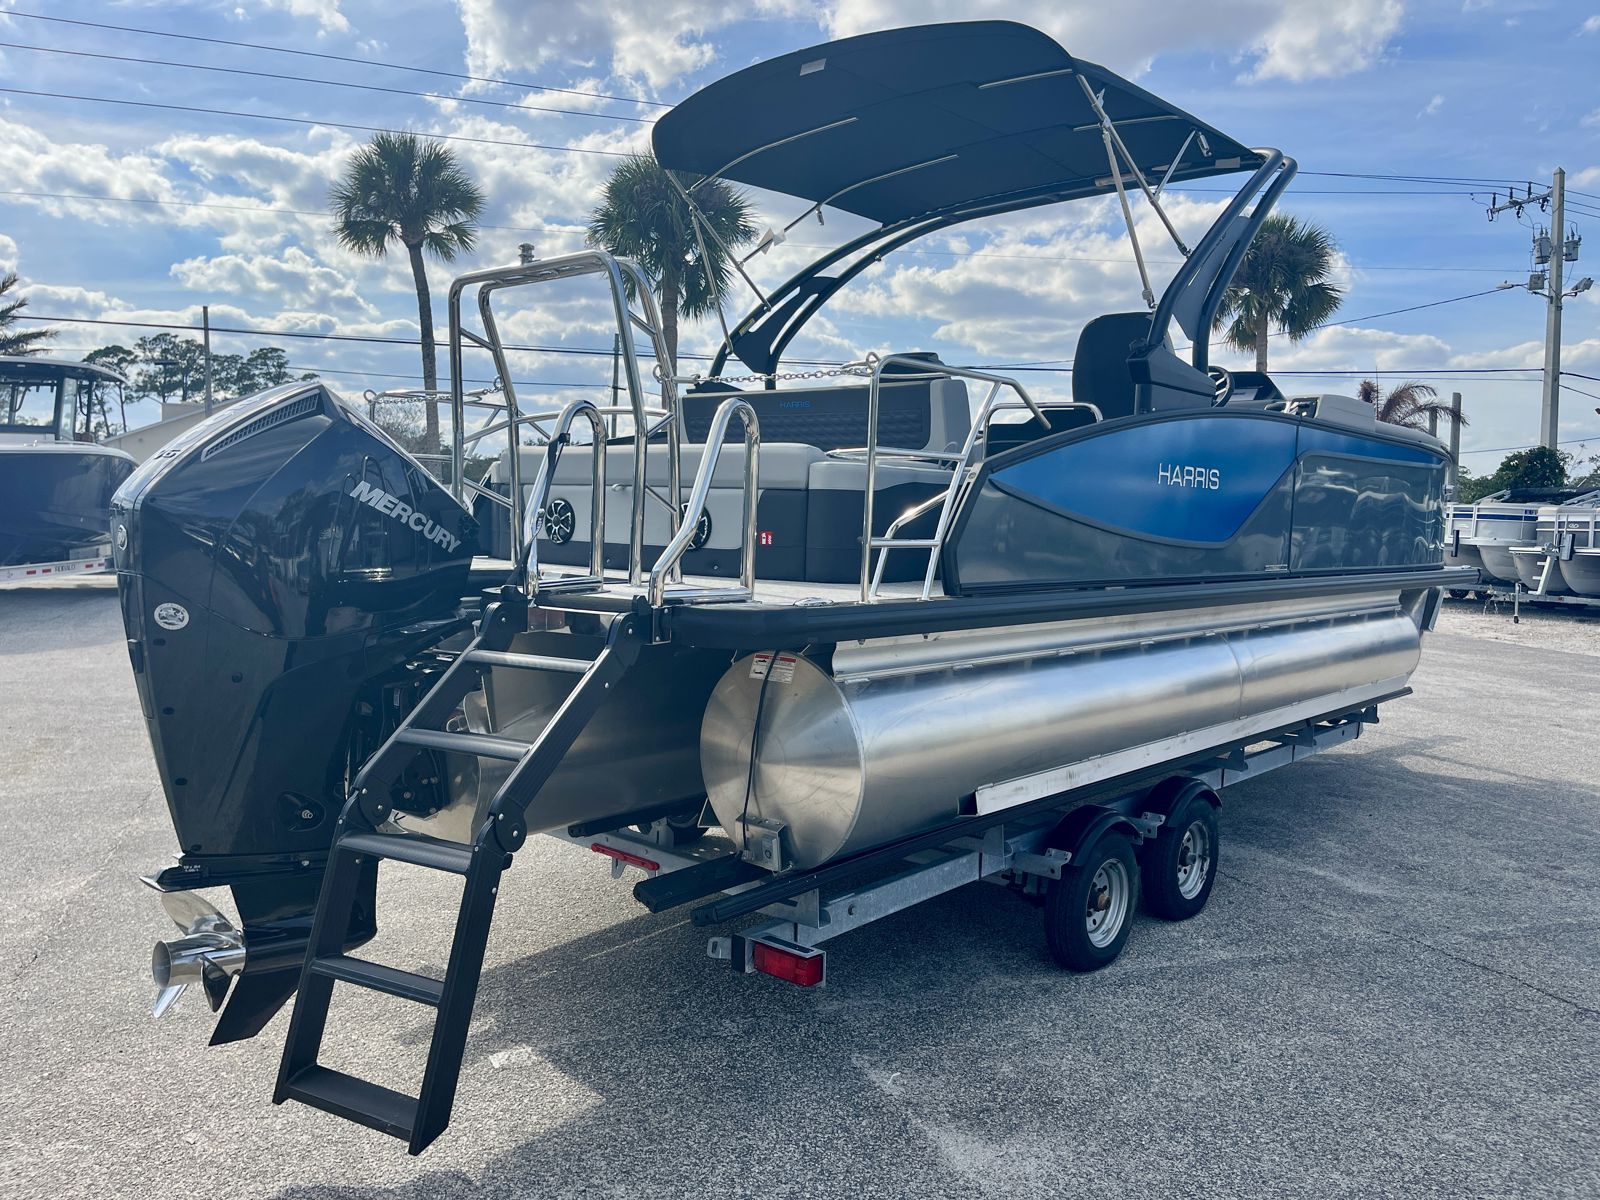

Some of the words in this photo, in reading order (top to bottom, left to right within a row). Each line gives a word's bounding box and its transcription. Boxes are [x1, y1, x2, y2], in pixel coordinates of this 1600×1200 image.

[780, 400, 810, 408] HARRIS
[1158, 462, 1220, 490] HARRIS
[349, 480, 462, 554] MERCURY
